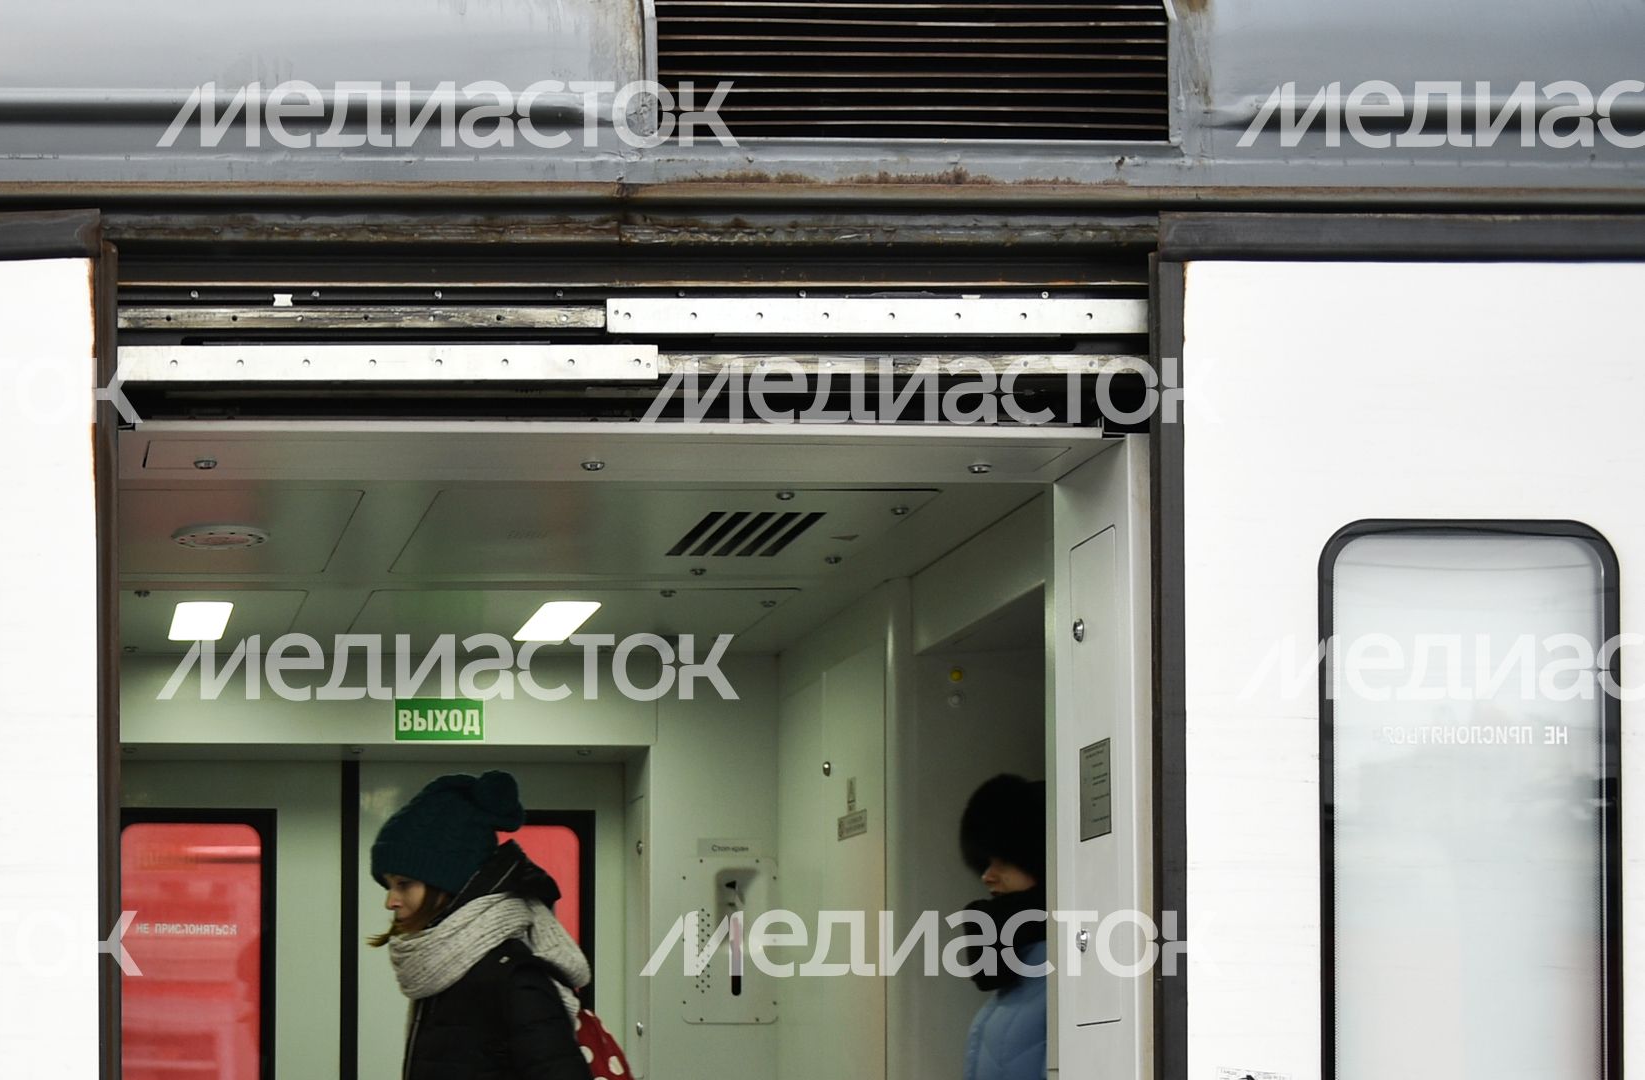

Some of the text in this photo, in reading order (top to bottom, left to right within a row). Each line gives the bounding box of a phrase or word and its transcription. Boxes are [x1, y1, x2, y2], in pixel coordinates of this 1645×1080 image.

[398, 709, 481, 736] ВЫХОД
[136, 923, 237, 936] НЕ ПРИСЛОНЯТЬСЯ
